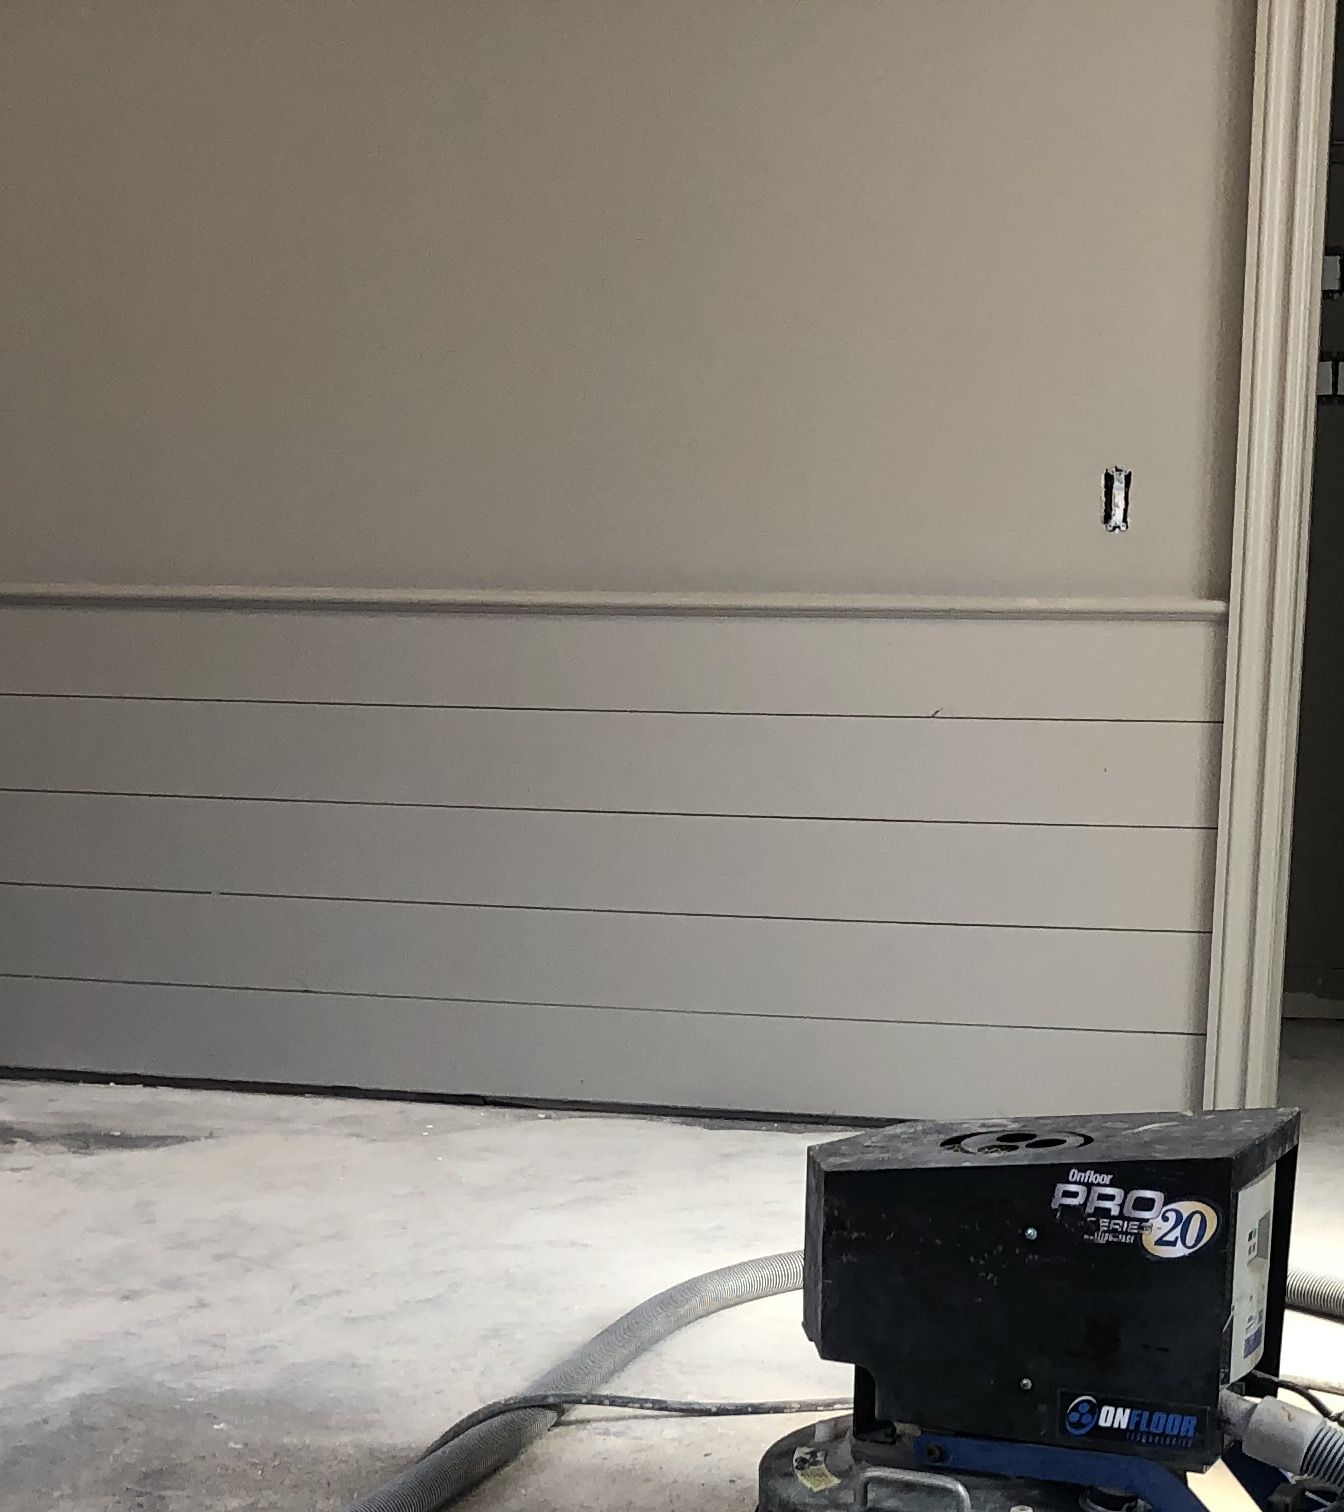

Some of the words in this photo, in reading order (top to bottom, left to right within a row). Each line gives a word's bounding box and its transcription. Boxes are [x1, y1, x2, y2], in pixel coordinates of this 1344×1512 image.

[1068, 1169, 1113, 1185] Onfloor
[1051, 1183, 1165, 1219] PRO
[1086, 1217, 1154, 1235] ERIES
[1154, 1208, 1208, 1250] 20
[1098, 1405, 1198, 1437] ONFLOOR
